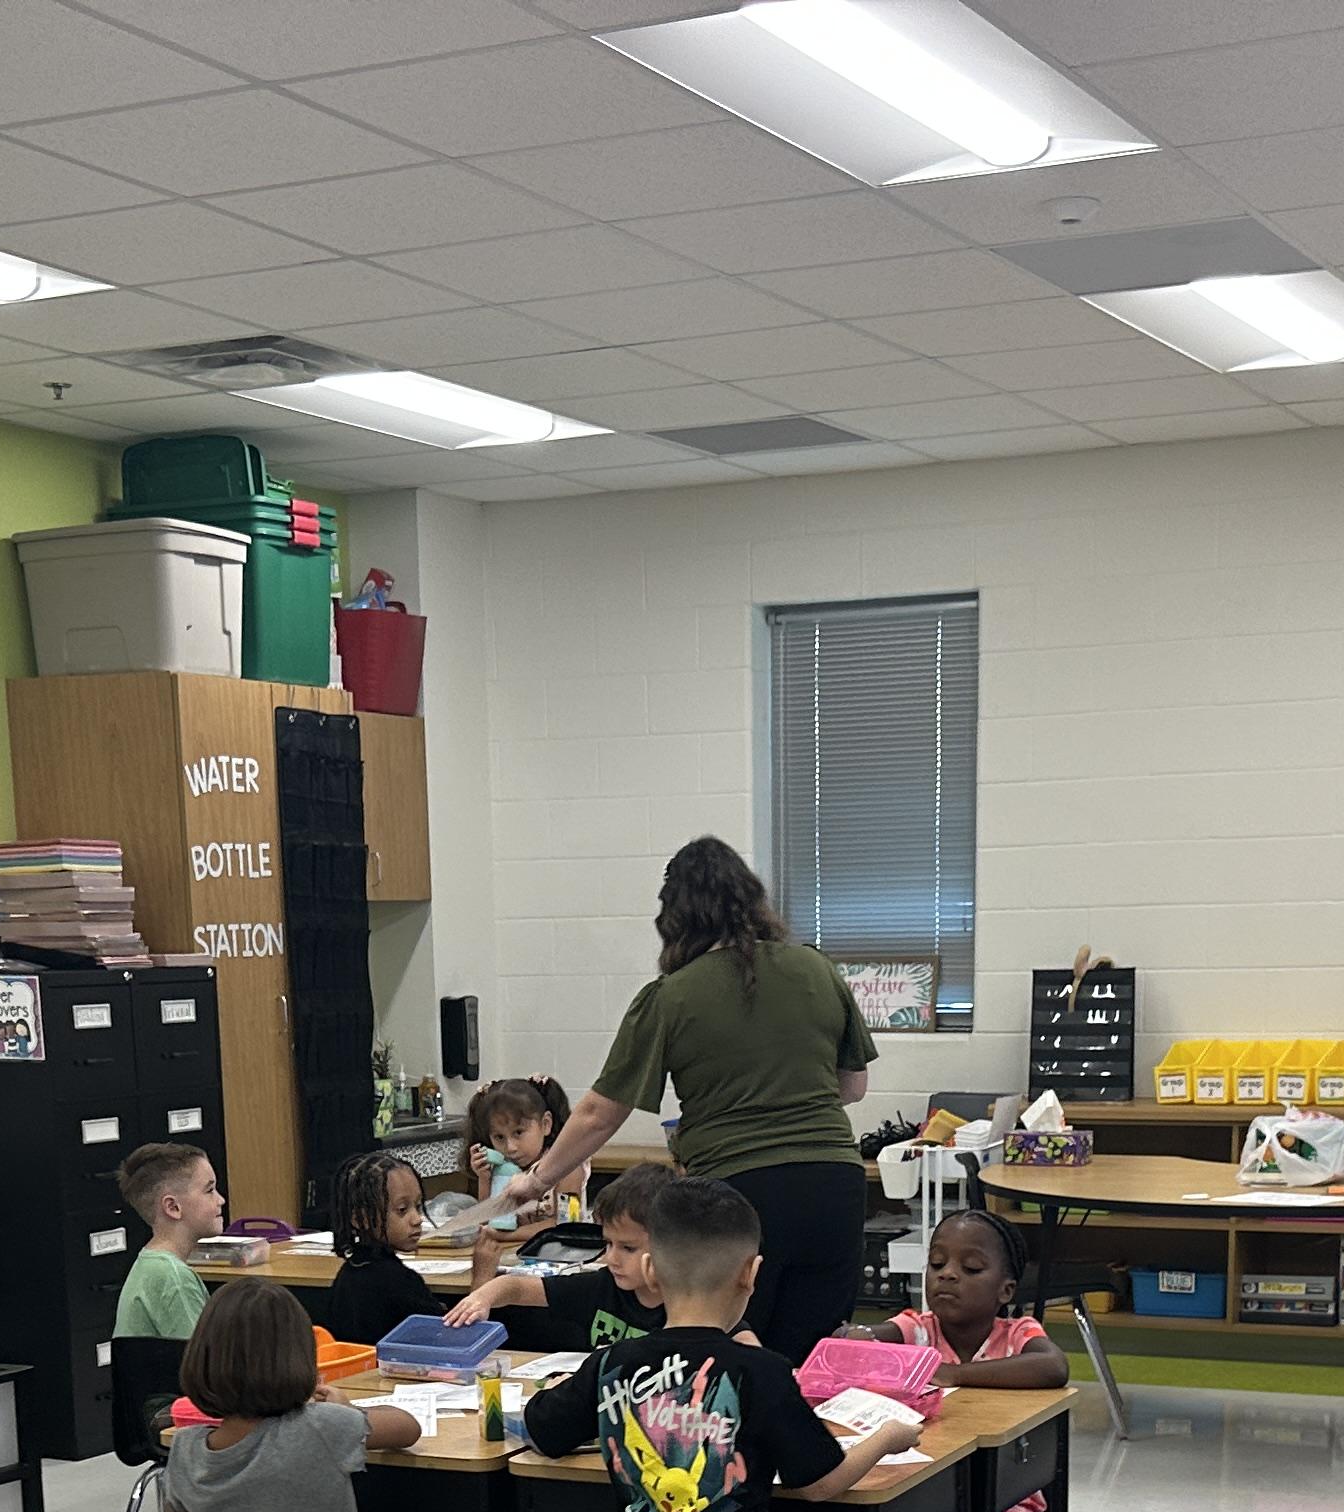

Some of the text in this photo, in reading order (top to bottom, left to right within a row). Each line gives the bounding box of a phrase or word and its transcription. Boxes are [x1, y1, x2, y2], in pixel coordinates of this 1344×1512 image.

[184, 755, 260, 798] WATER
[191, 842, 273, 882] BOTTLE
[193, 922, 285, 958] STATION
[1161, 1078, 1184, 1087] Group
[1199, 1080, 1222, 1089] Group
[1239, 1080, 1263, 1089] Group
[1279, 1080, 1303, 1089] Group
[1320, 1080, 1344, 1089] Group
[597, 1353, 689, 1425] HIGH
